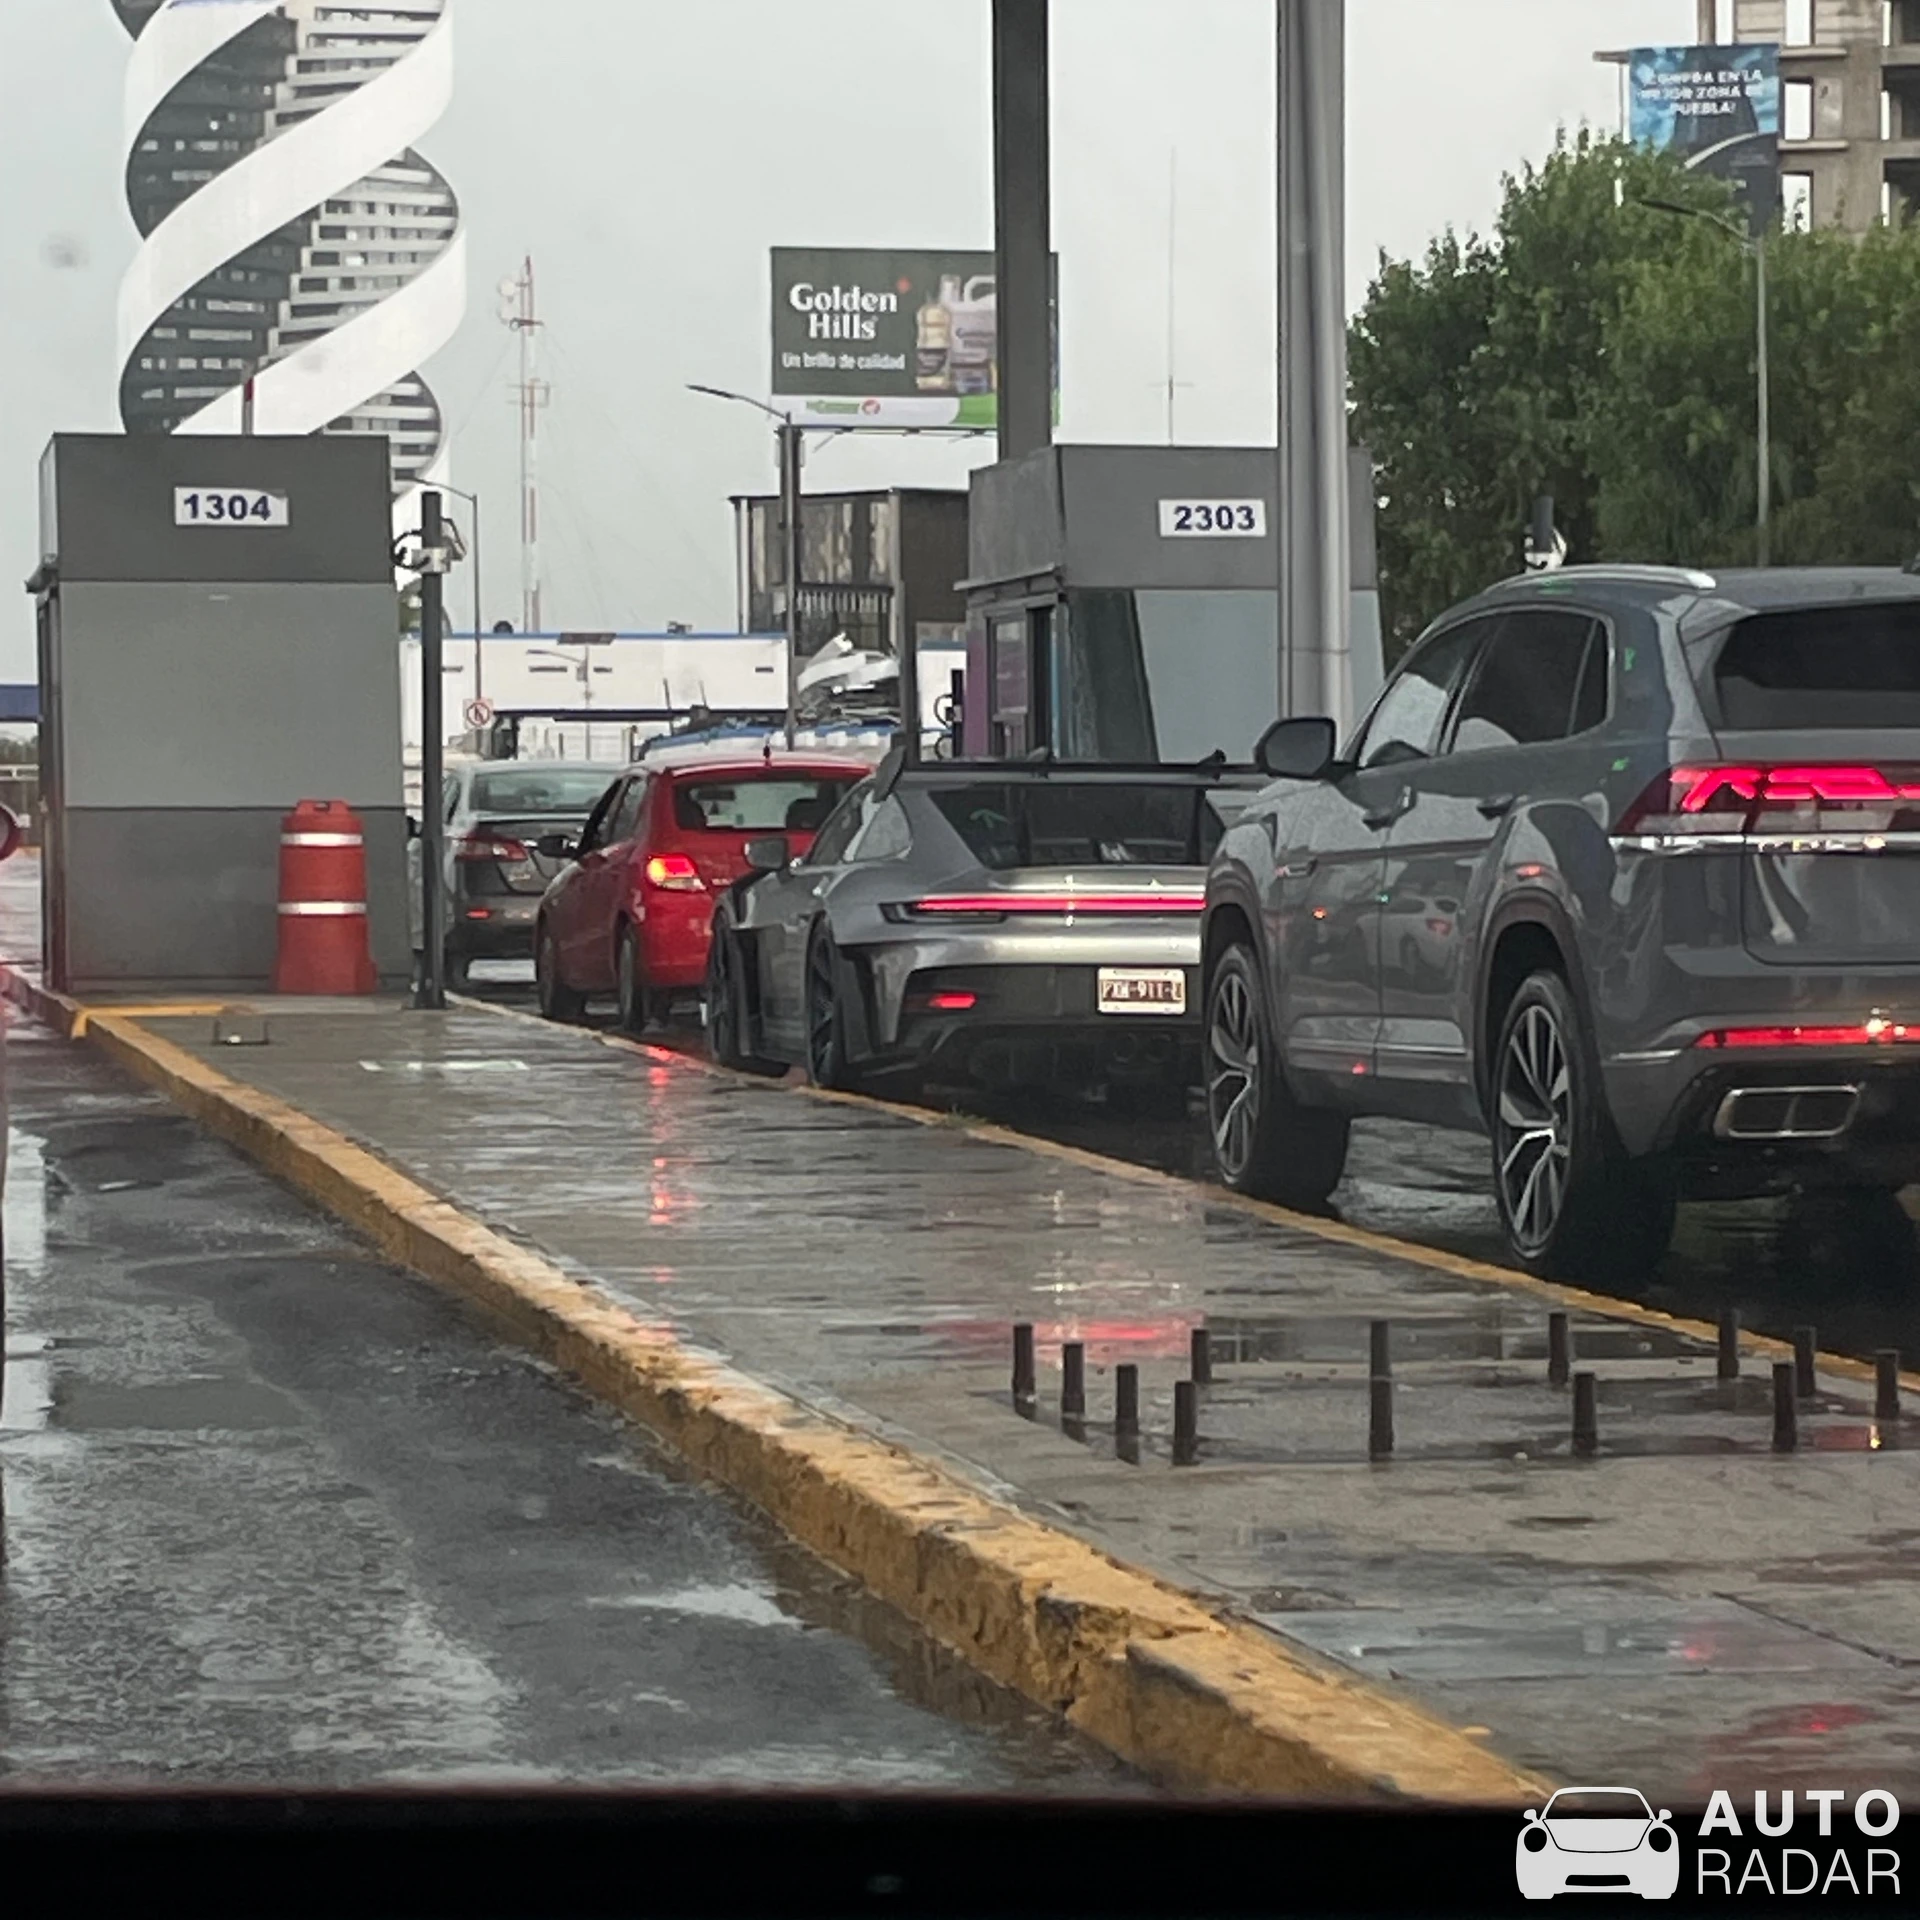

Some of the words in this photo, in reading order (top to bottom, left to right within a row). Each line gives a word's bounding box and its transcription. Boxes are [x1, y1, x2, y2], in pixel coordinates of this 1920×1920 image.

[1696, 85, 1741, 99] ZONA
[789, 283, 898, 313] Golden
[808, 313, 877, 340] Hills
[781, 352, 801, 368] Un
[838, 353, 855, 370] de
[857, 352, 906, 370] calidad
[184, 493, 271, 521] 1304
[1173, 505, 1255, 531] 2303
